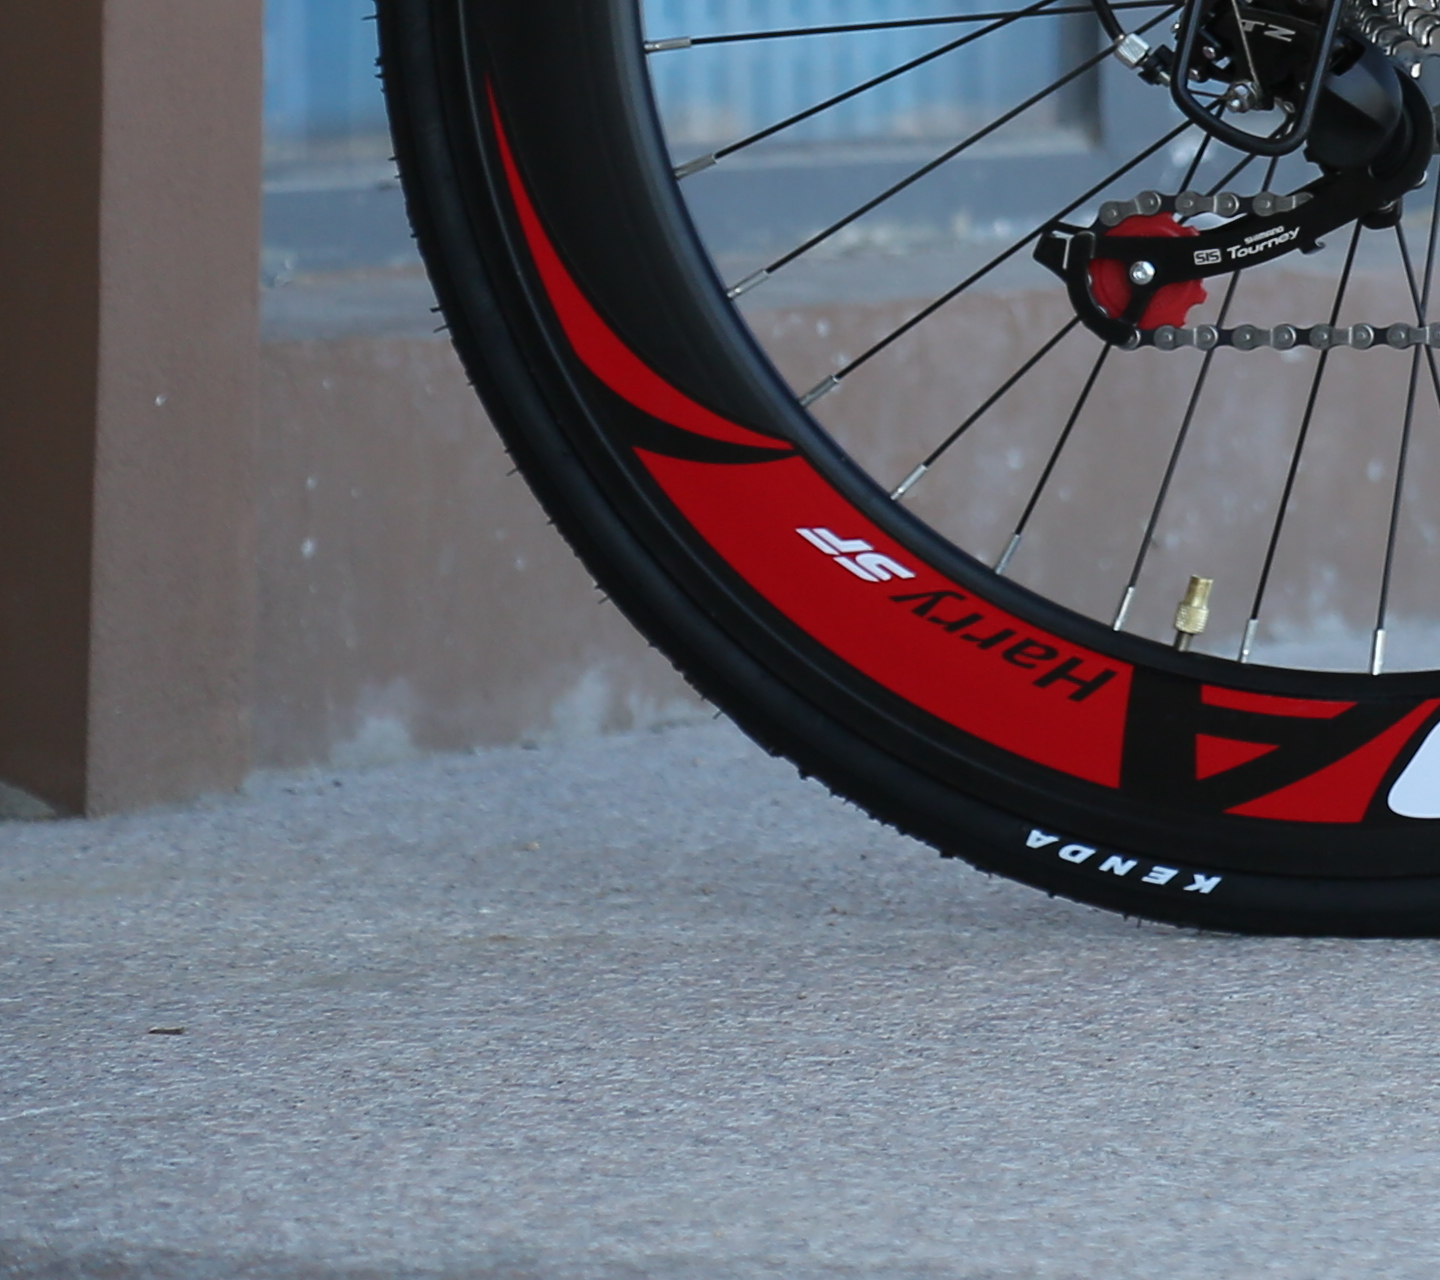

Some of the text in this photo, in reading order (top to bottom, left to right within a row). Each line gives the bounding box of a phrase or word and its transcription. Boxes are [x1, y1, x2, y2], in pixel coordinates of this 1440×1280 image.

[1195, 249, 1221, 265] SIS
[795, 528, 916, 582] SF
[889, 590, 1117, 702] Harry
[1026, 829, 1222, 894] KENDA
